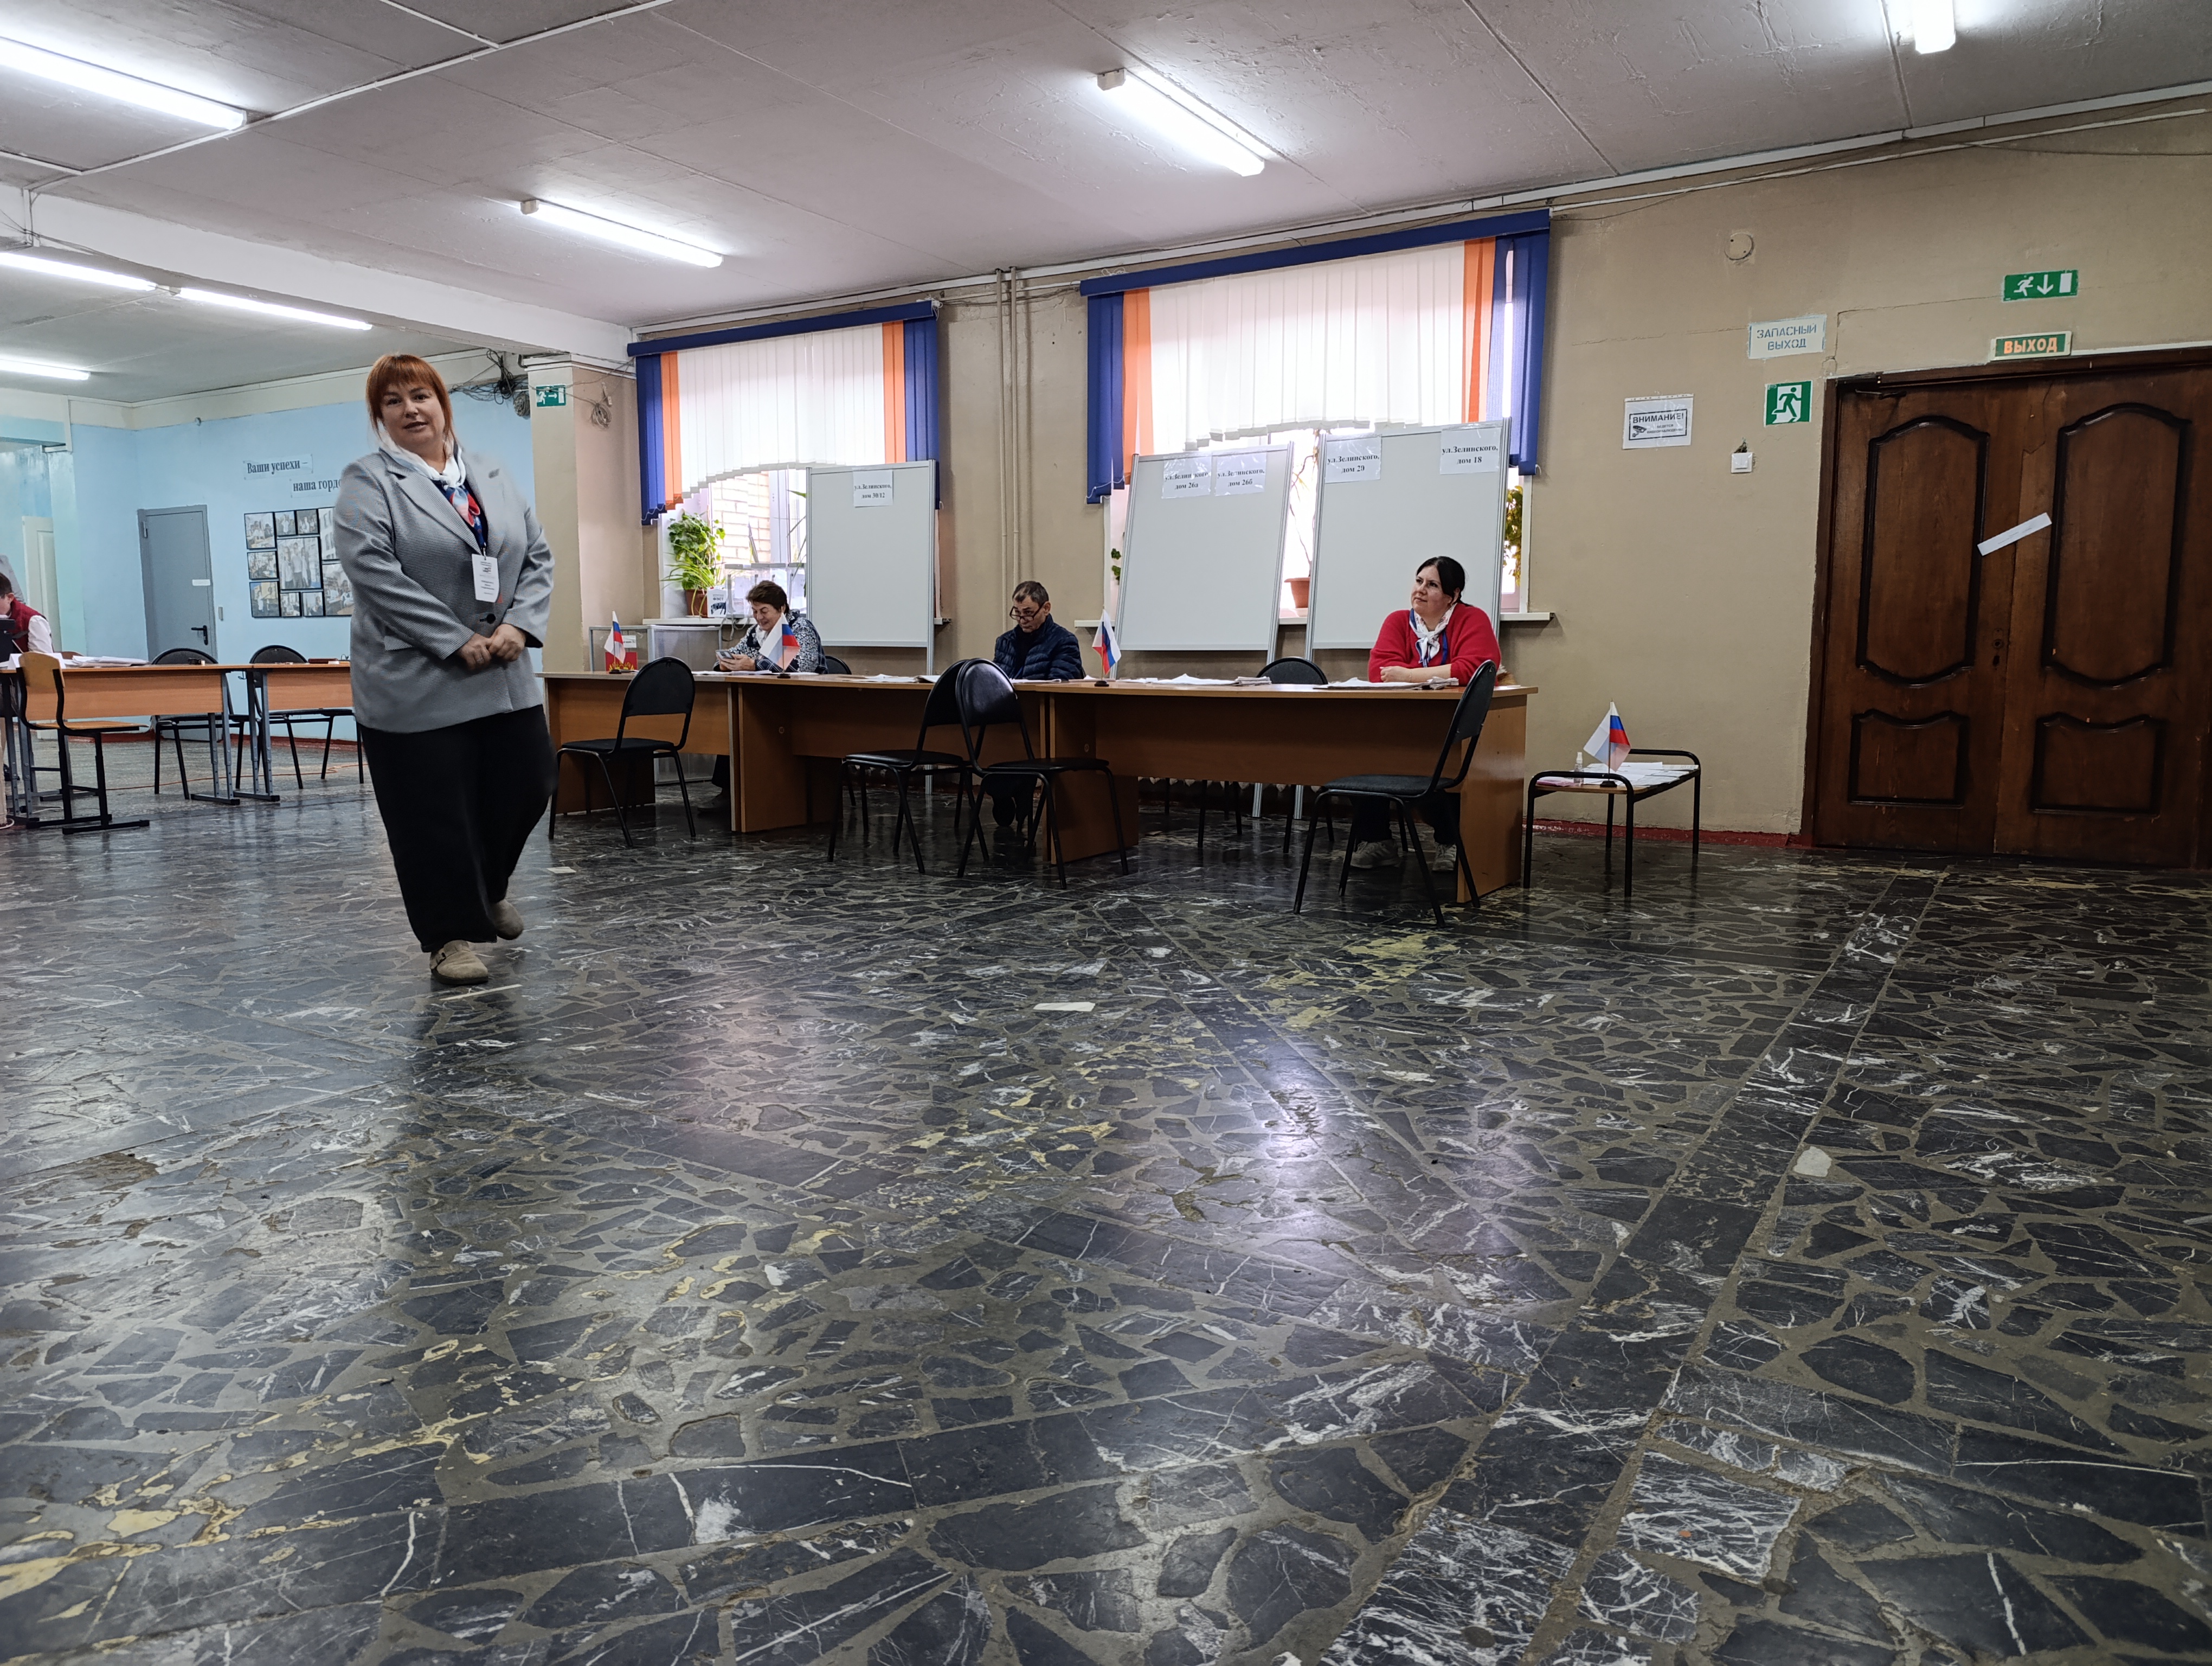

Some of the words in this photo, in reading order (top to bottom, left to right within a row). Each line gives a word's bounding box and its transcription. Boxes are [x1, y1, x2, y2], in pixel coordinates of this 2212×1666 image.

[1757, 323, 1816, 338] ЗАПАСНЫЙ
[1767, 338, 1806, 350] ВЫХОД
[2004, 337, 2057, 354] ВЫХОД
[1632, 413, 1684, 424] ВНИМАНИЕ!
[1442, 445, 1499, 456] ул.Зелинского,
[1327, 454, 1380, 465] ул.Зелинского,
[247, 463, 270, 474] Ваши
[271, 460, 300, 475] успехи
[293, 482, 317, 491] наша
